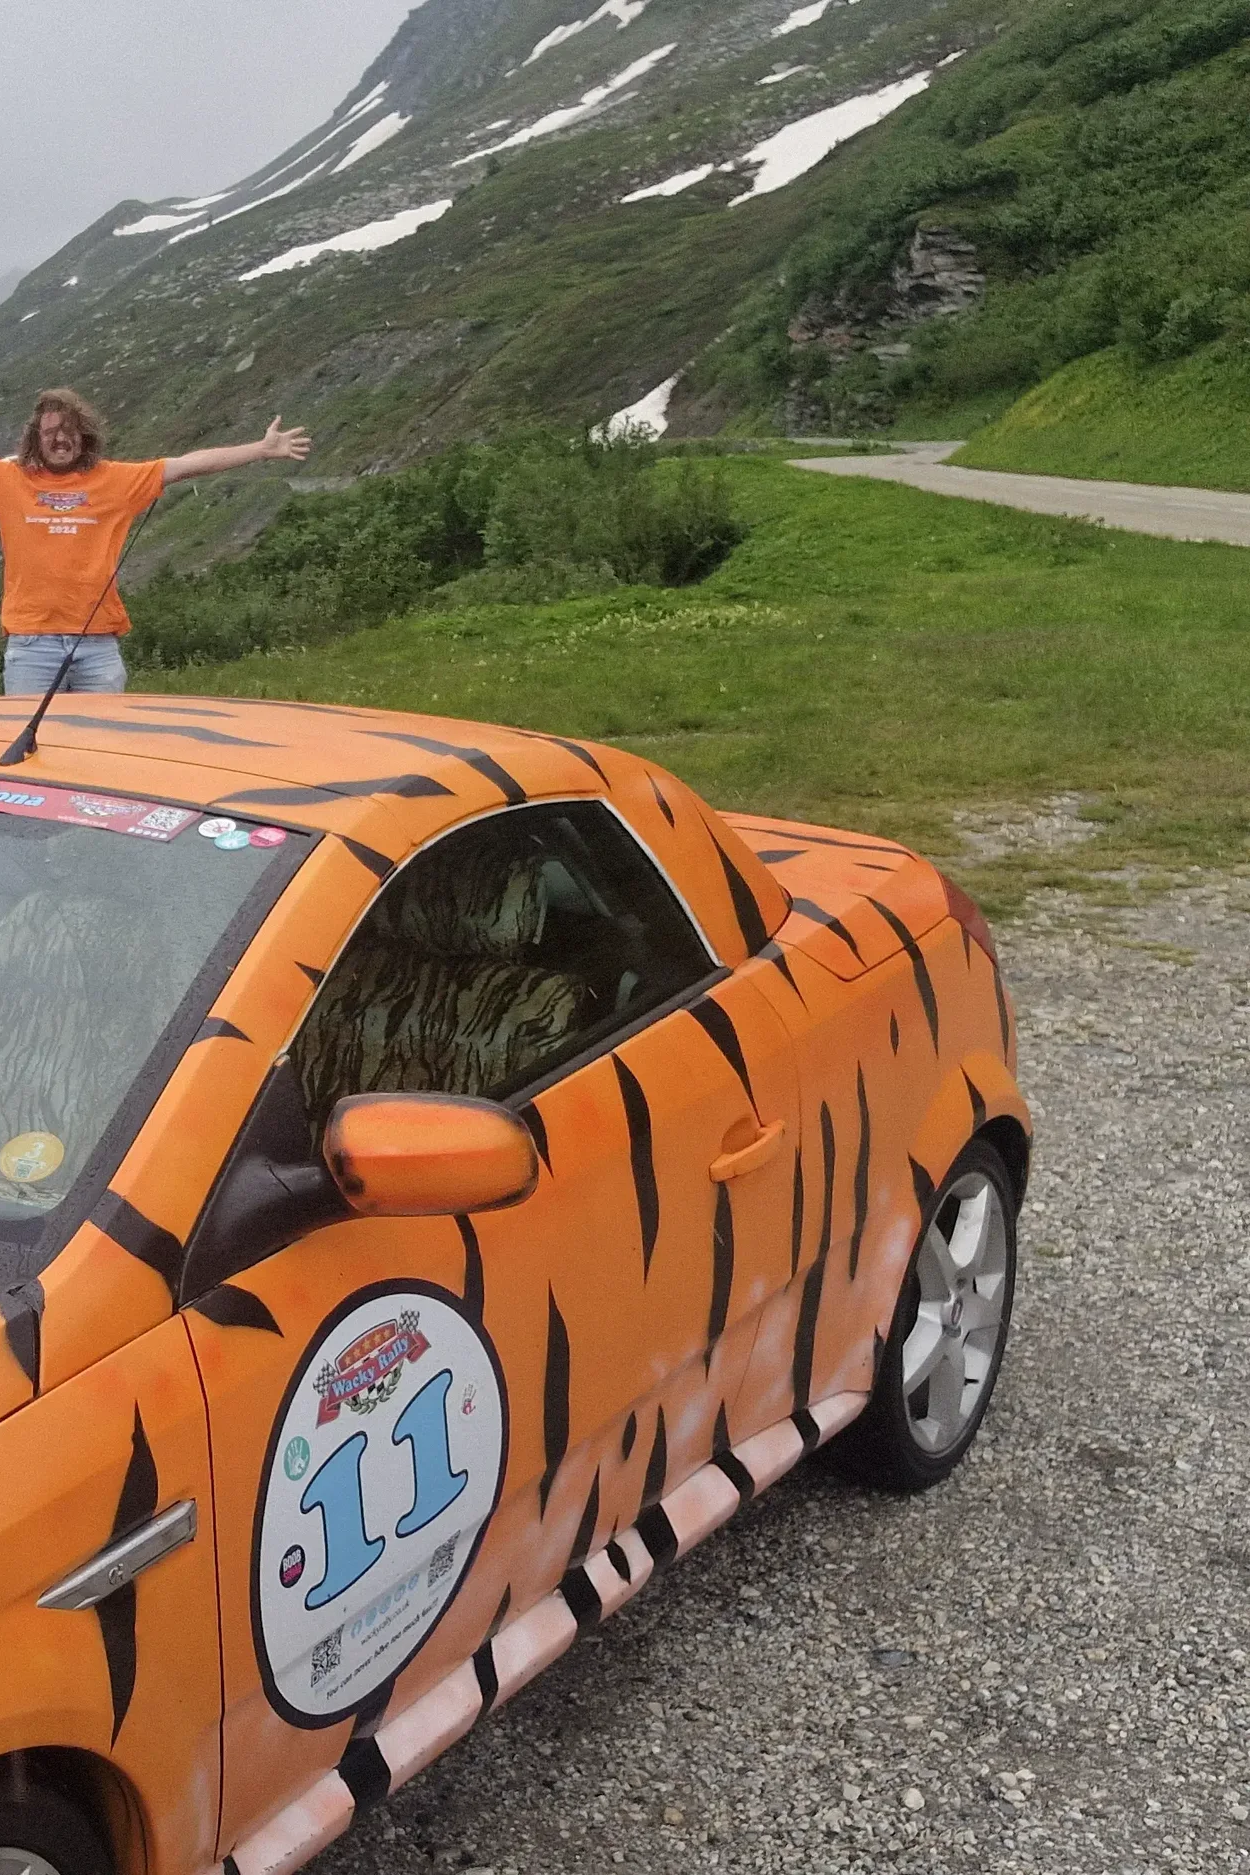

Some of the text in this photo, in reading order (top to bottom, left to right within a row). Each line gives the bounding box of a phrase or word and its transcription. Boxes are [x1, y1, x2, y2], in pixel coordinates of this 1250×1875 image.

[332, 1336, 408, 1397] Wacky Rally
[300, 1368, 468, 1611] 11
